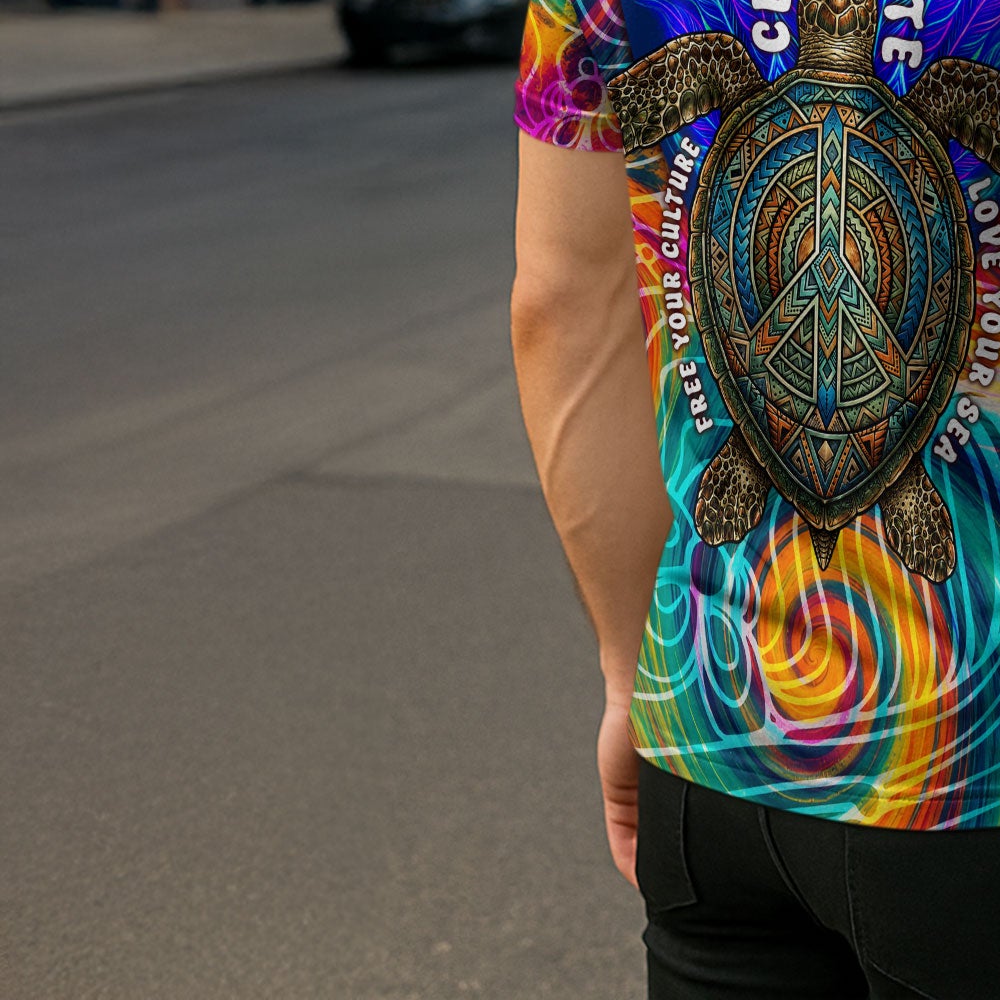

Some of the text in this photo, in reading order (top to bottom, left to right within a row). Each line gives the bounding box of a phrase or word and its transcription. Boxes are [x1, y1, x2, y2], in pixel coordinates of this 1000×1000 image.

[661, 136, 713, 434] FREE YOUR CULTURE
[933, 397, 980, 464] SEA
